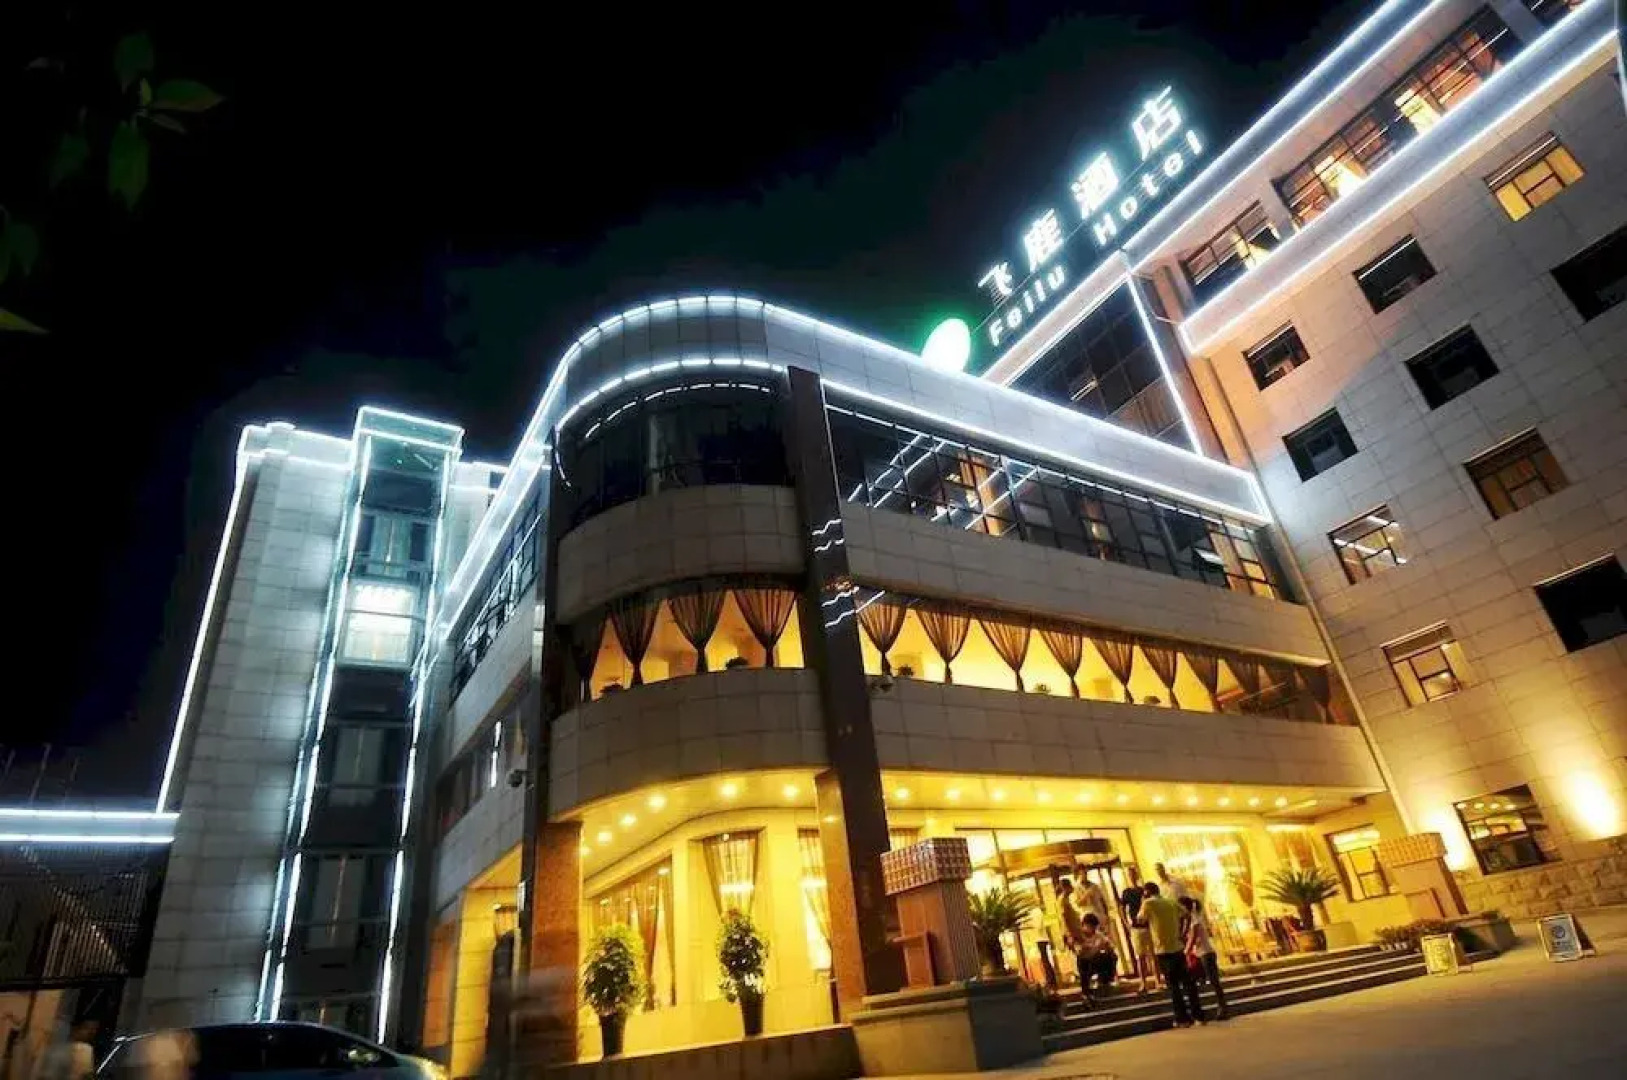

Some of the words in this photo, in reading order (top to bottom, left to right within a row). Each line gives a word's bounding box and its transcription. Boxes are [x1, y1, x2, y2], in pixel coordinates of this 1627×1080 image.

[978, 86, 1182, 295] 飞鹿酒店
[989, 266, 1066, 346] Feilu
[1093, 130, 1202, 245] Hotel
